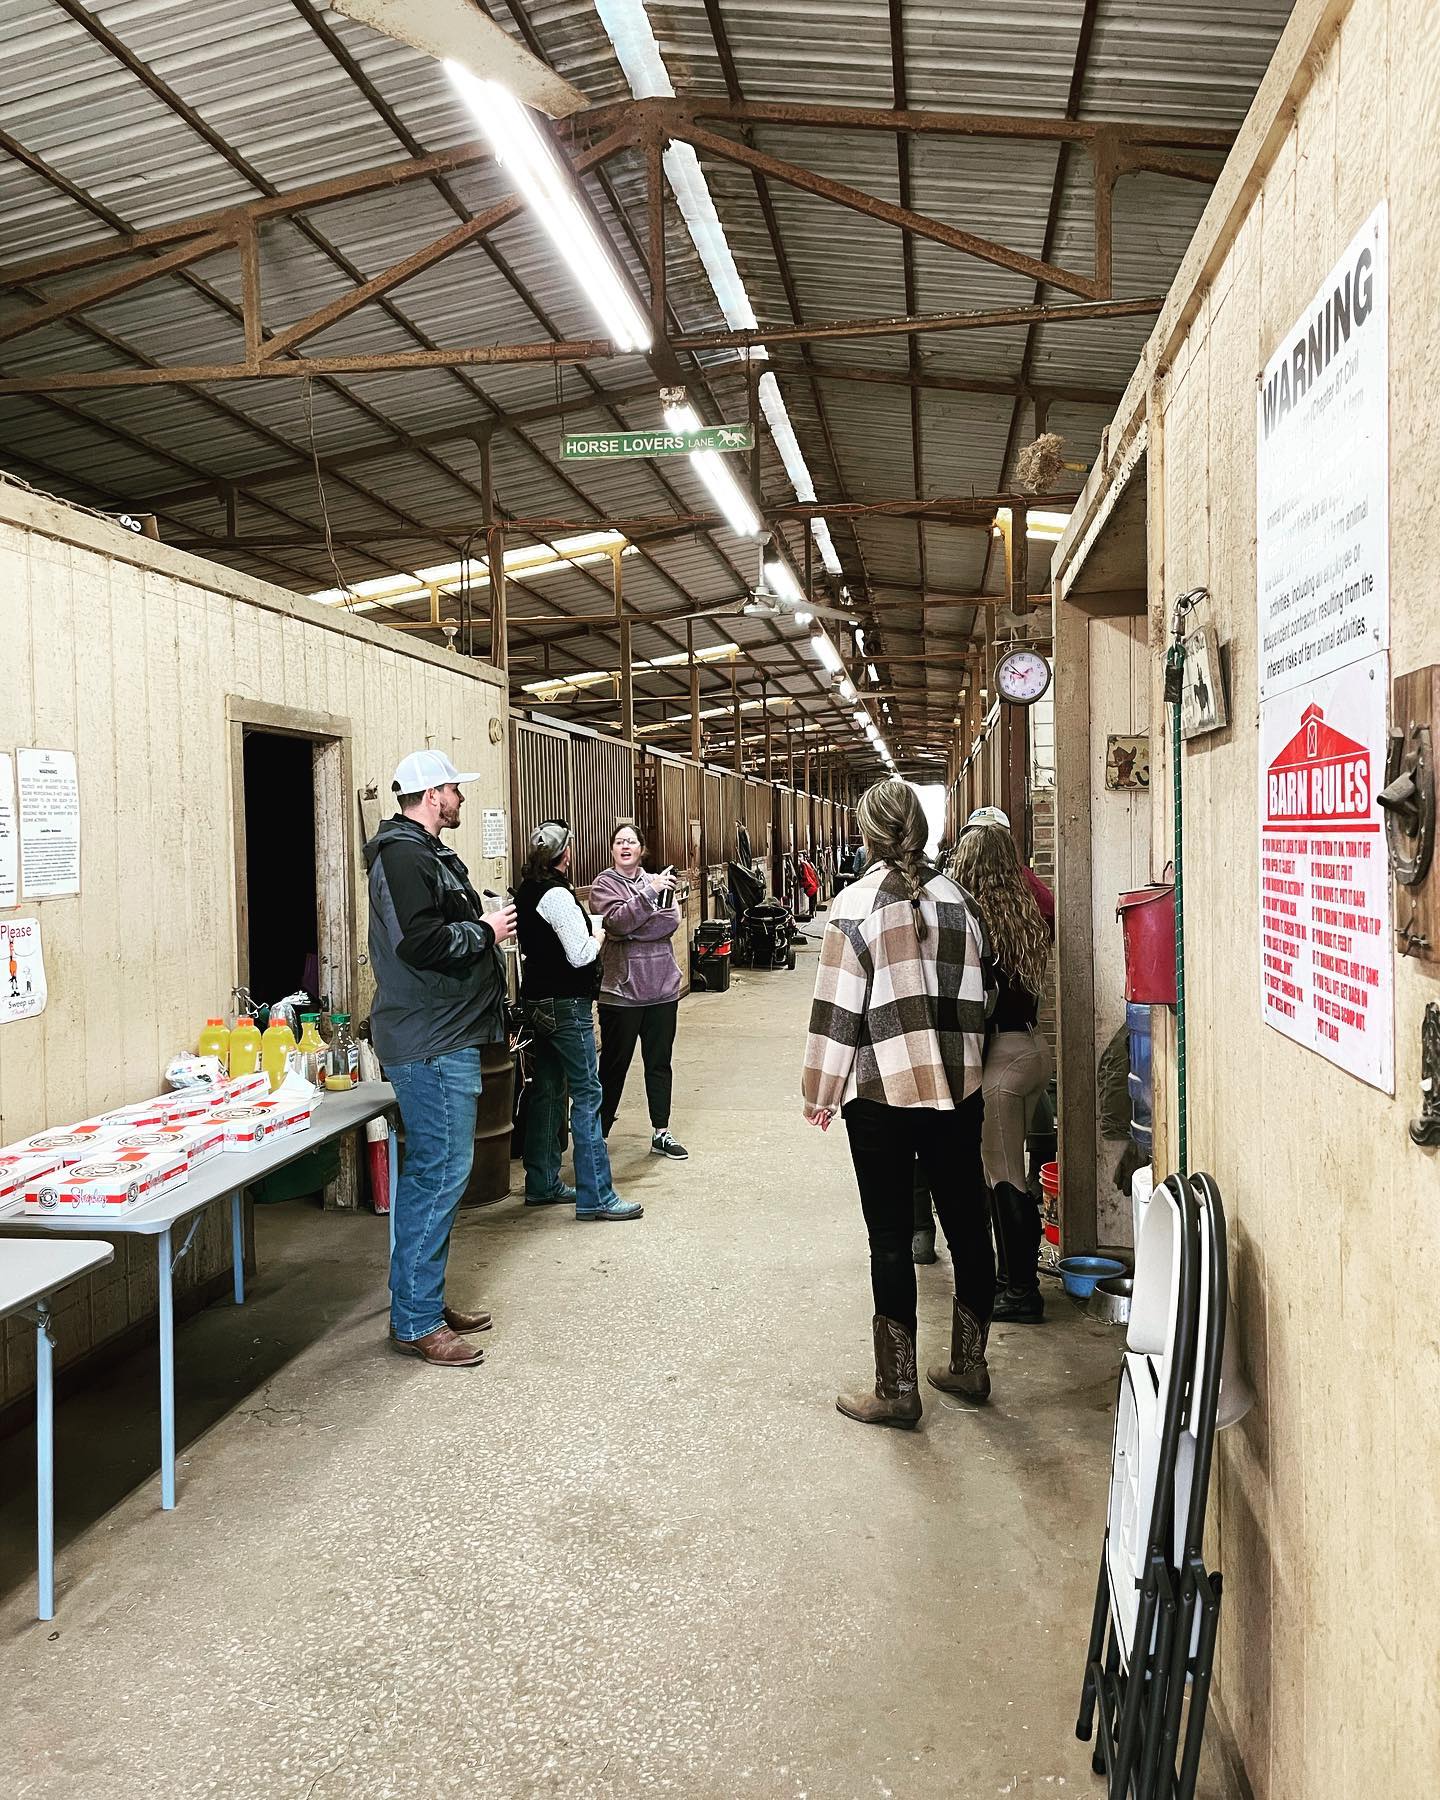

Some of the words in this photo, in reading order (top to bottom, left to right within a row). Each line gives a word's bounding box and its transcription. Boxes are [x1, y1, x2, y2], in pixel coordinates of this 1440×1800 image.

[1263, 247, 1373, 440] WARNING
[566, 439, 619, 454] HORSE
[623, 436, 684, 452] LOVERS
[688, 437, 715, 448] LANE
[1291, 576, 1315, 604] including
[1318, 590, 1344, 619] resulting
[1344, 582, 1361, 606] from
[1361, 571, 1374, 596] the
[1266, 660, 1285, 680] inherent
[1285, 649, 1298, 671] risks
[1298, 642, 1304, 665] of
[1304, 641, 1317, 662] farm
[1317, 624, 1336, 656] animal
[1336, 614, 1368, 646] activities.
[1269, 769, 1308, 817] BARN
[1311, 758, 1369, 815] RULES
[0, 925, 32, 939] Please
[8, 1000, 26, 1008] Sweep
